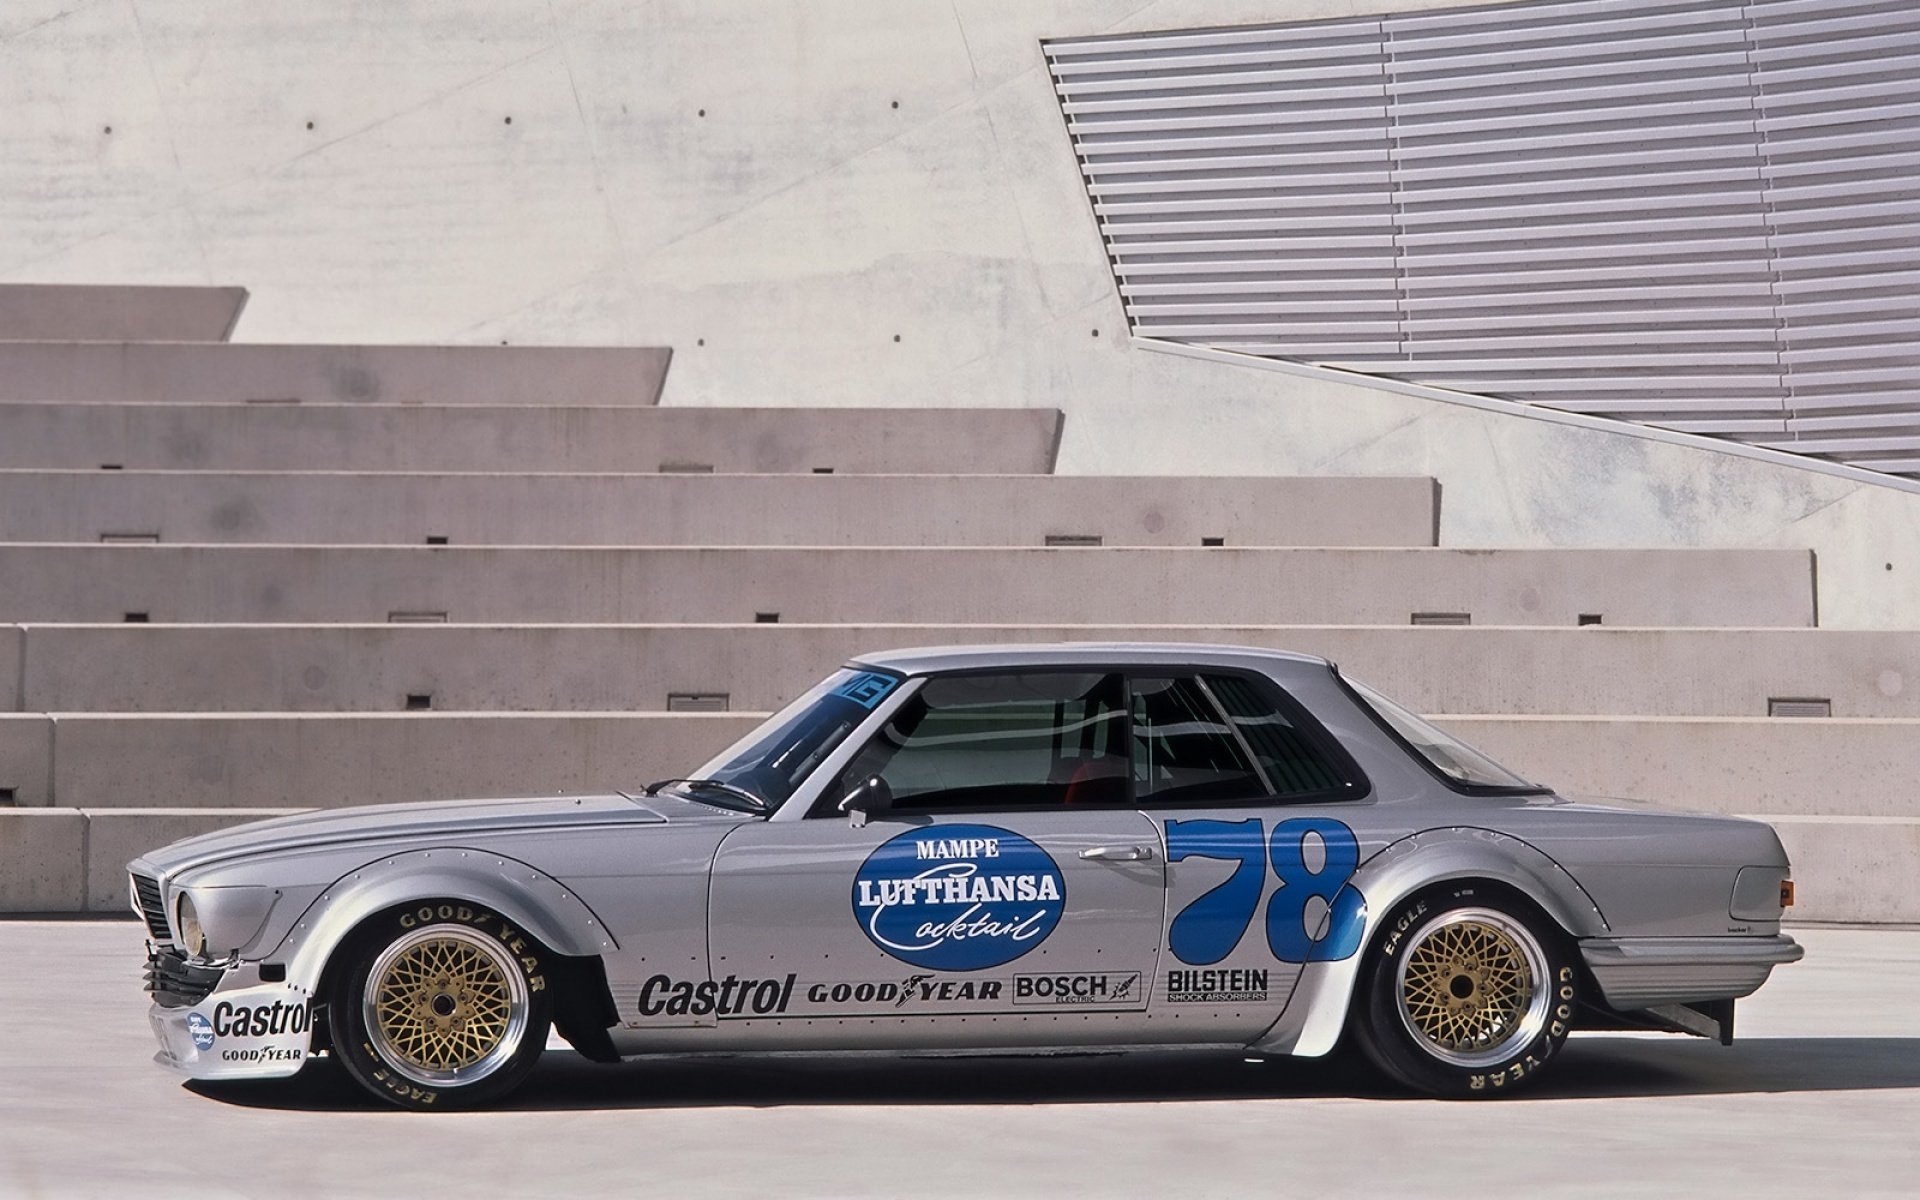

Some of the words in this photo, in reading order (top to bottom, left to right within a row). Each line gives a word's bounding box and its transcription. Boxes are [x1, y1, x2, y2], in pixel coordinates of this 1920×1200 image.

[916, 838, 1000, 860] MAMPE
[858, 874, 1060, 906] LUFTHANSA
[1164, 817, 1367, 965] 78
[869, 863, 1047, 951] Cocktail
[1383, 899, 1428, 956] EAGLE
[637, 973, 798, 1016] Castrol
[1016, 975, 1108, 997] BOSCH
[1168, 969, 1268, 992] BILSTEIN
[1168, 993, 1204, 1002] SHOCK
[1205, 991, 1267, 1001] ABSORBERS
[1055, 995, 1096, 1004] ELECTRIC
[213, 999, 312, 1038] Castrol
